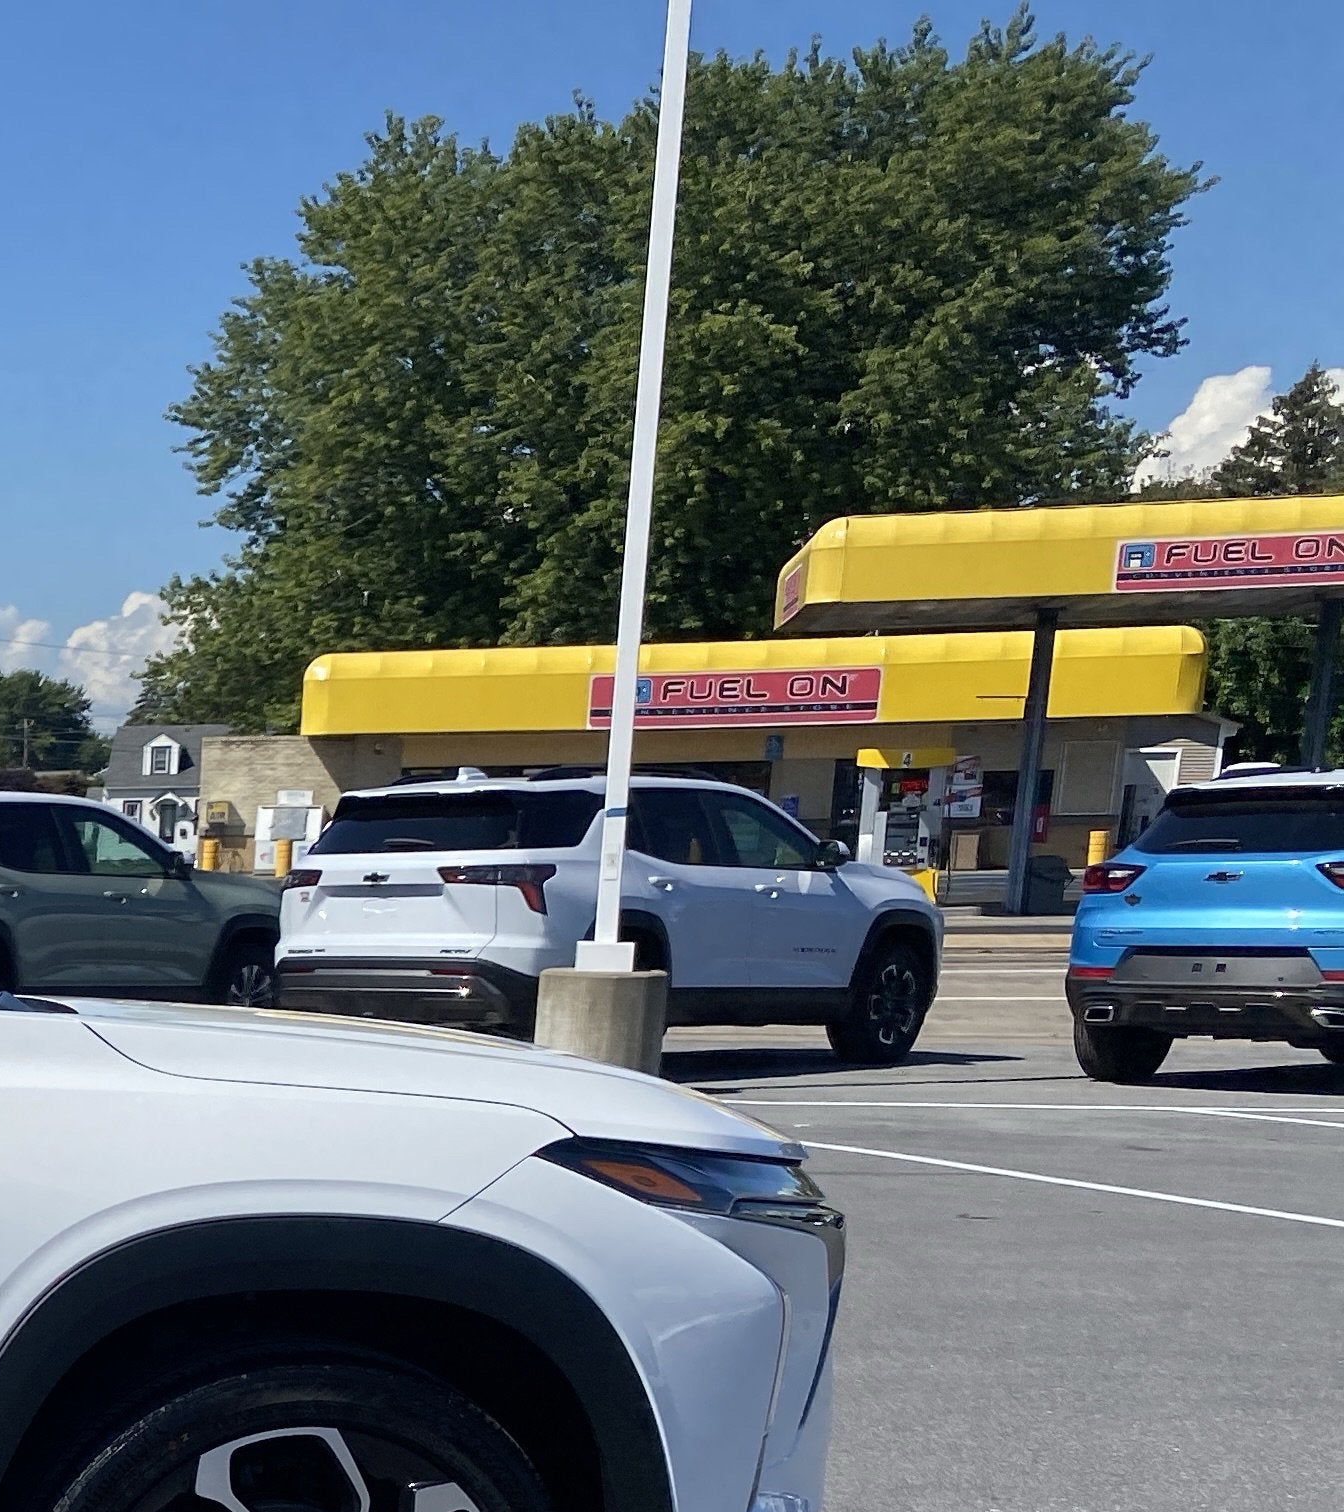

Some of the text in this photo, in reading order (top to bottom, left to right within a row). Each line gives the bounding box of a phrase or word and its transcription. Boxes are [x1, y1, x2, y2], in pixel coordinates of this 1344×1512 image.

[1164, 537, 1344, 565] FUEL ON
[661, 674, 849, 701] FUEL ON
[609, 705, 767, 714] NVENIENCE
[903, 753, 912, 767] 4
